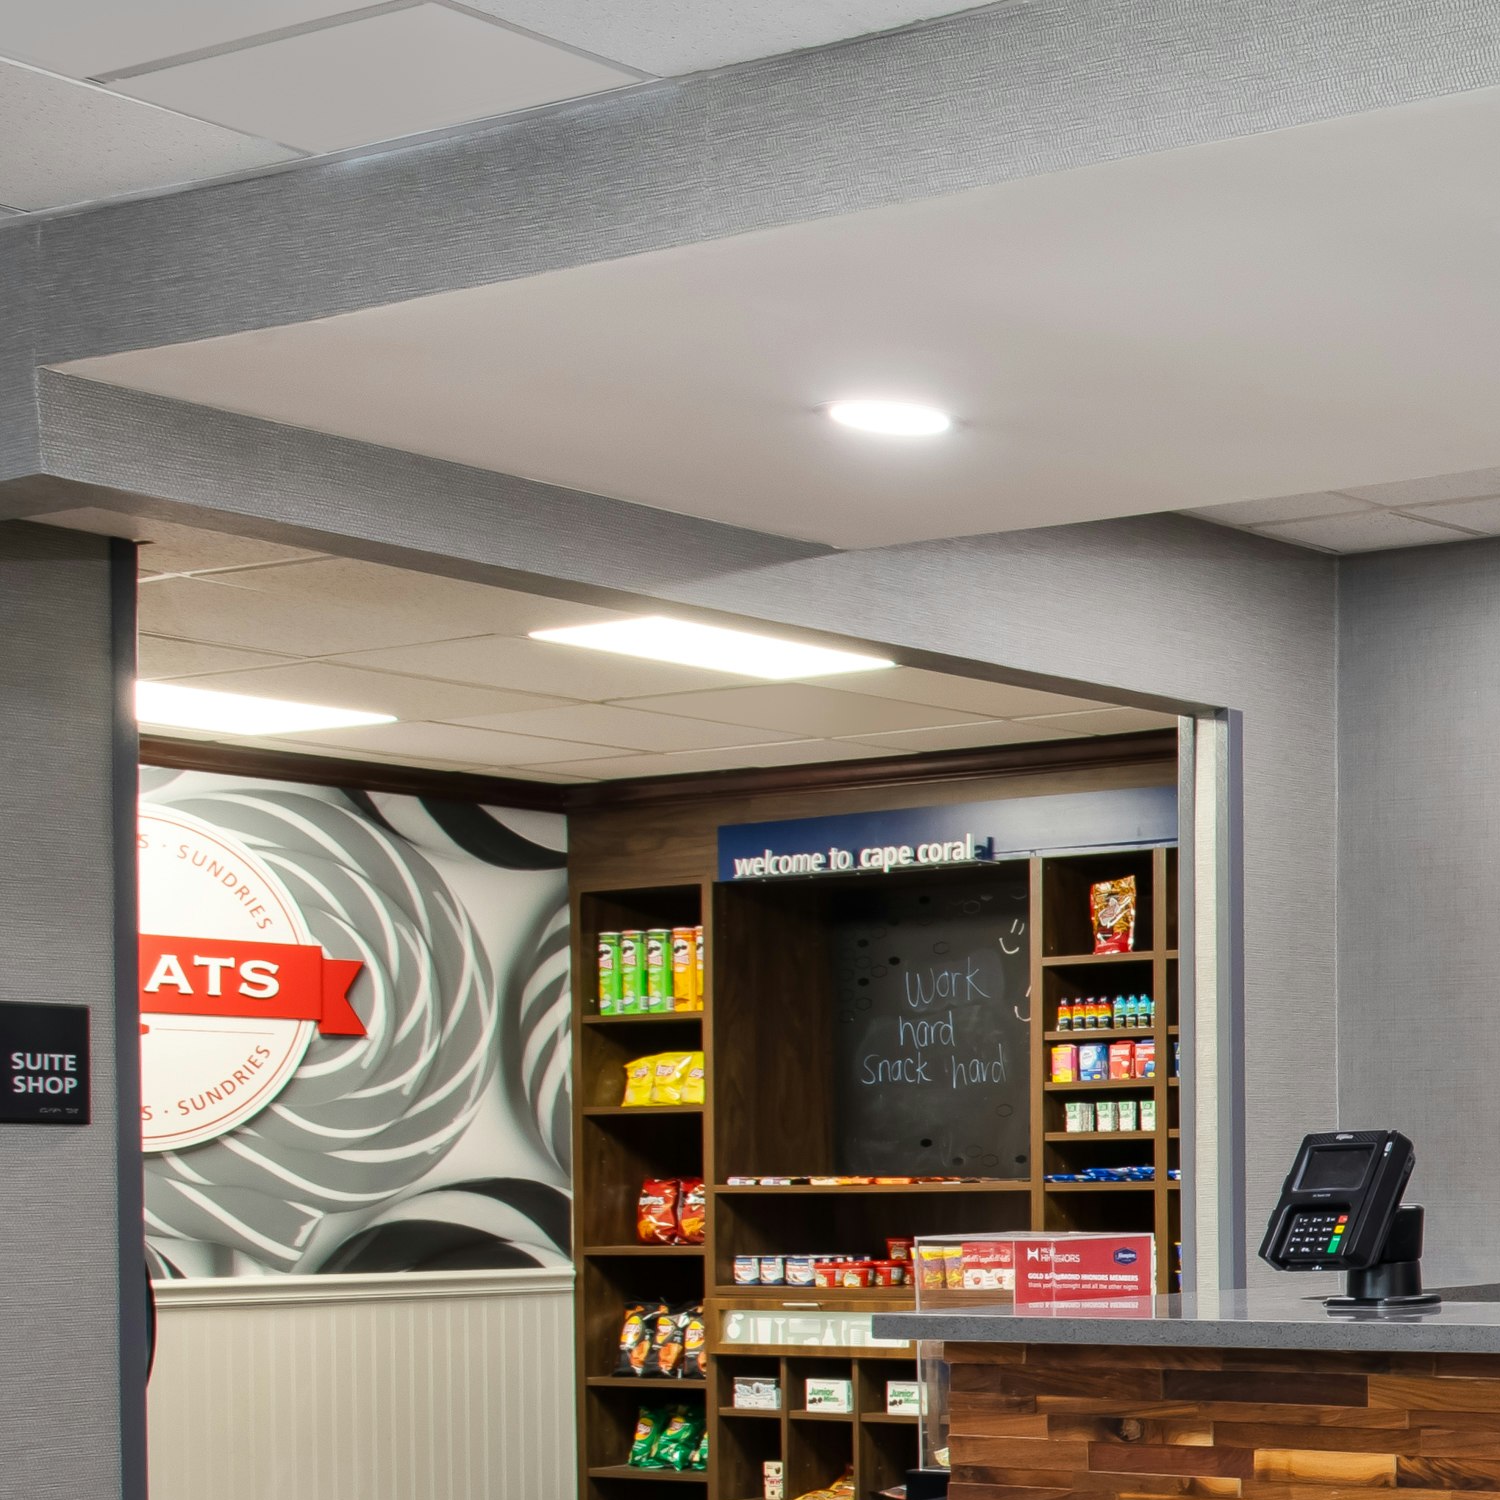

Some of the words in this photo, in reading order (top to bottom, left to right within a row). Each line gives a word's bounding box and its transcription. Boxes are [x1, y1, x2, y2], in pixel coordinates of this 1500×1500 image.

[734, 849, 823, 877] welcome
[829, 847, 852, 870] to
[860, 845, 911, 873] cape
[916, 833, 974, 863] coral
[177, 844, 273, 931] SUNDRIES
[899, 1010, 955, 1049] hard
[11, 1052, 77, 1071] SUITE
[177, 1045, 271, 1116] SUNDRIES
[952, 1043, 1006, 1088] hard
[13, 1075, 78, 1094] SHOP
[809, 1387, 835, 1397] Junior
[890, 1388, 915, 1398] Junior
